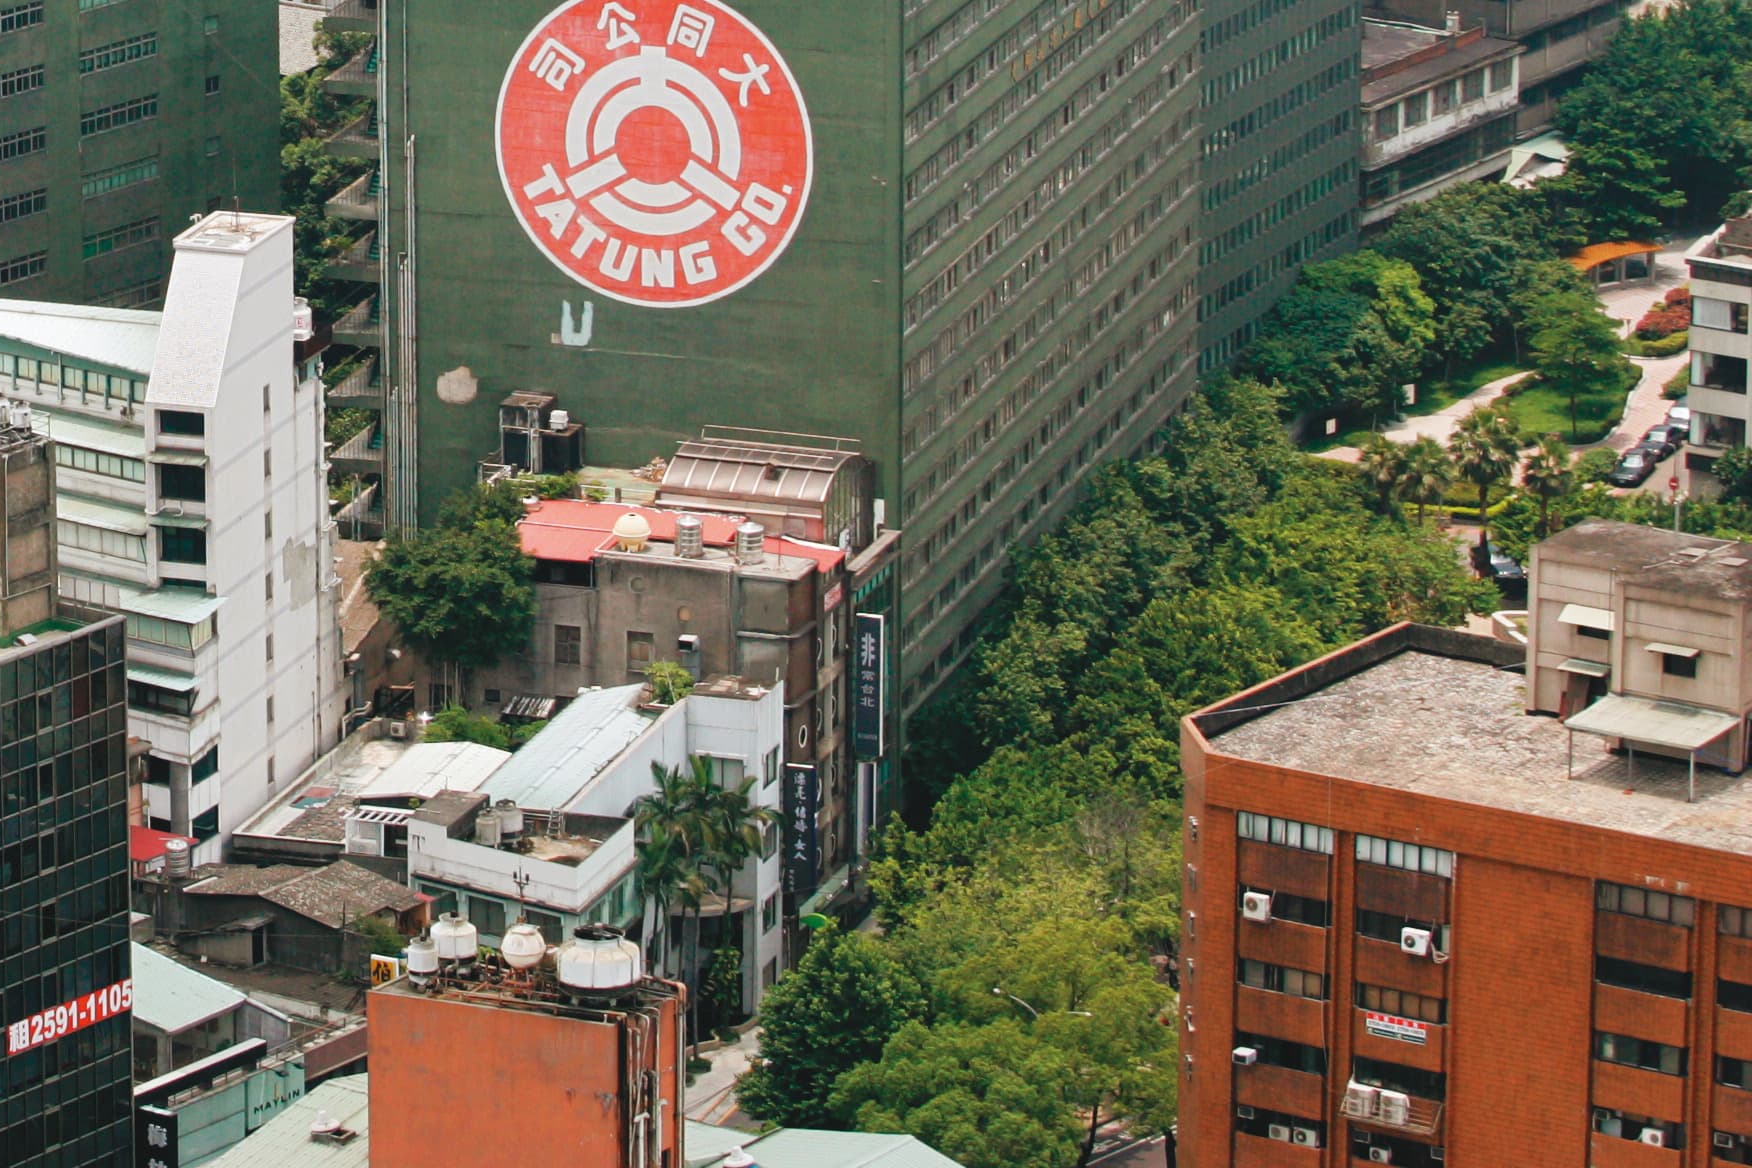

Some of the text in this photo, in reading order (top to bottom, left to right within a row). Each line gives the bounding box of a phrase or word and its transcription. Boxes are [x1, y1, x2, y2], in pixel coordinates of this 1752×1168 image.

[528, 1, 771, 108] 大同公司
[523, 162, 793, 288] TATUNG CO.
[860, 632, 876, 707] 非常台北
[254, 1089, 300, 1115] MAYLIN
